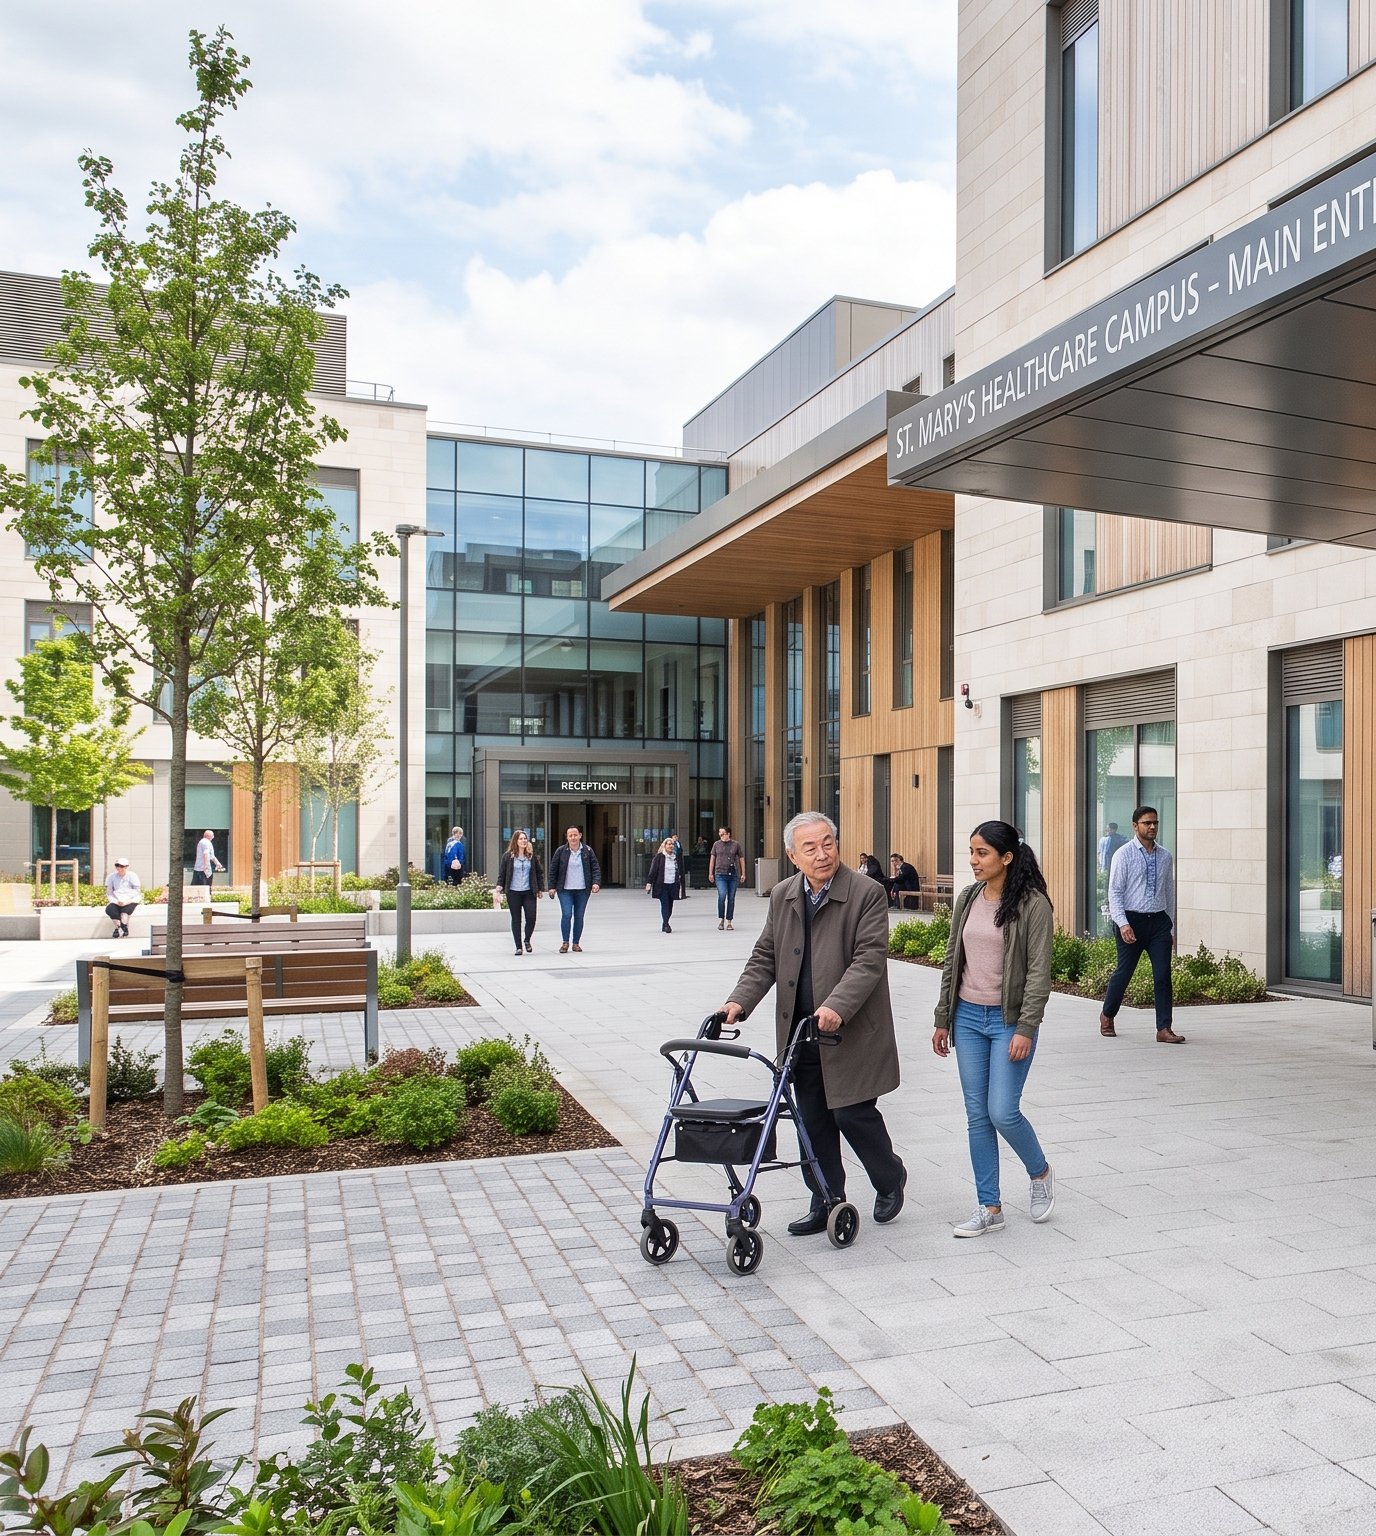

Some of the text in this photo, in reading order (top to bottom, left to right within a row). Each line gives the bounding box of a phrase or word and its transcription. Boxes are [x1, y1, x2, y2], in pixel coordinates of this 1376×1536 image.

[896, 422, 914, 459] ST.
[918, 389, 976, 449] MARY'S
[981, 326, 1098, 417] HEALTHCARE
[1104, 271, 1200, 354] CAMPUS
[1228, 217, 1301, 296] MAIN
[561, 781, 617, 791] RECEPTION
